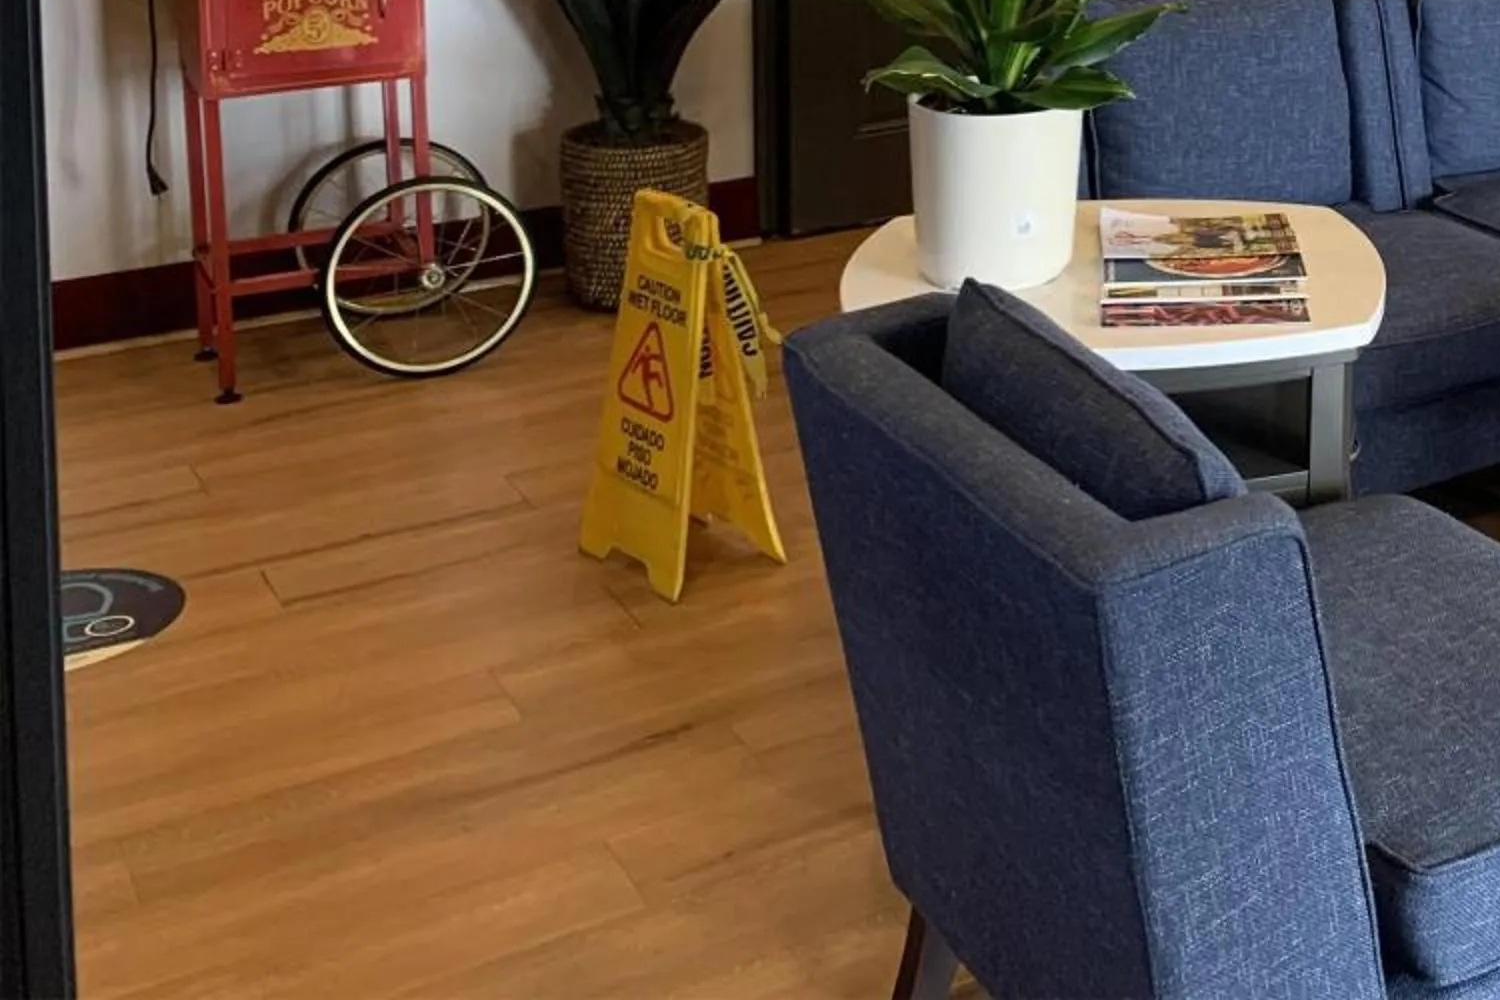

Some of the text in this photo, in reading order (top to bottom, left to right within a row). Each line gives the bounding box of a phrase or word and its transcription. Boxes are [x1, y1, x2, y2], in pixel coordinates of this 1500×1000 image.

[637, 273, 681, 303] CAUTION
[651, 300, 687, 327] FLOOR
[621, 417, 665, 452] CUIDADO
[617, 456, 658, 490] MOJADO
